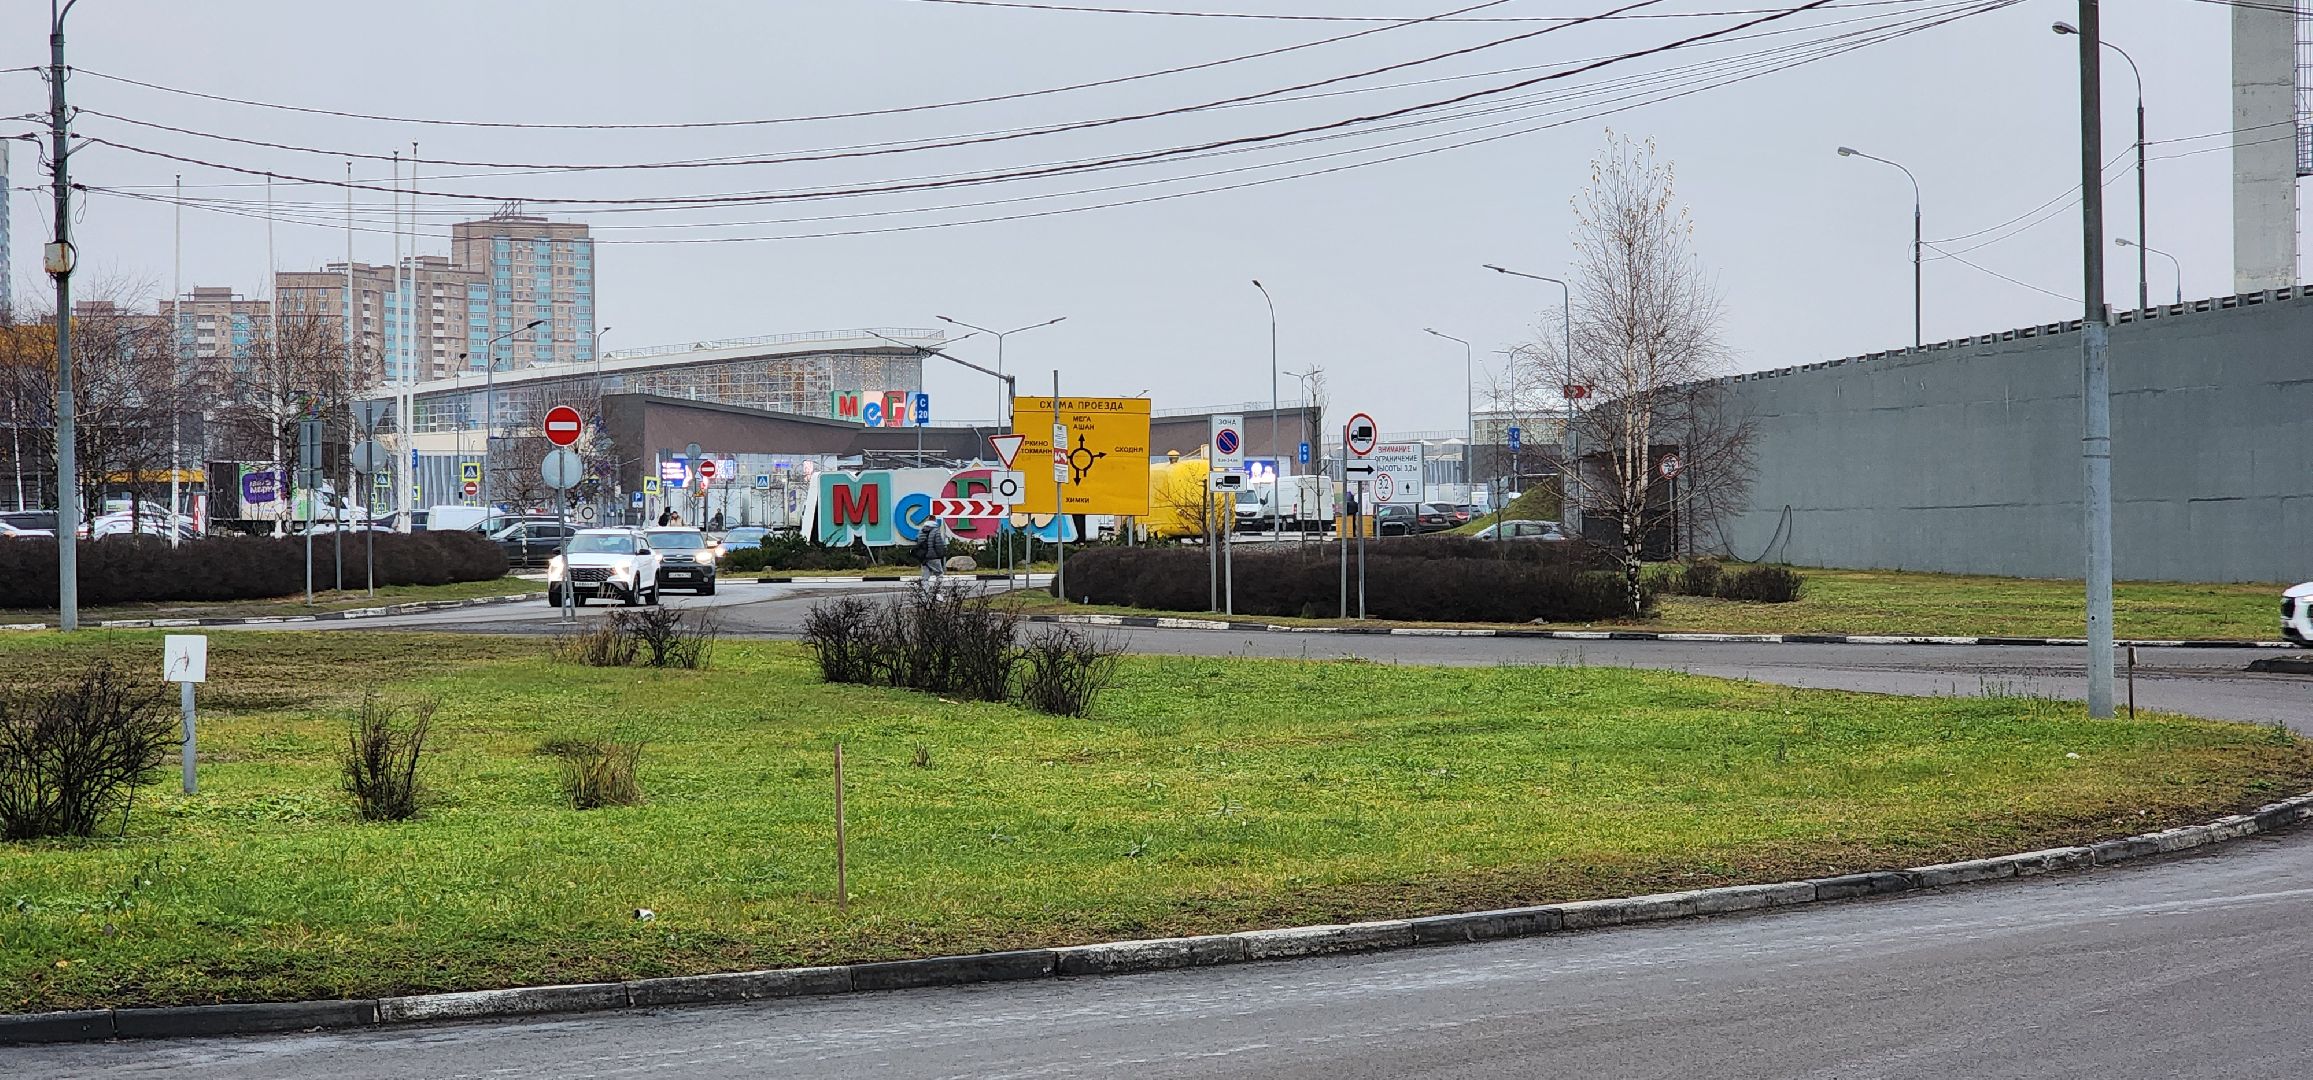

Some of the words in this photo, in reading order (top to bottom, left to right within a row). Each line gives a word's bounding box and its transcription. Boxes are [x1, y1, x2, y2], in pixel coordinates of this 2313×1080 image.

[1039, 400, 1074, 409] СХМА
[1078, 401, 1124, 411] ПРОЕЗДА
[918, 410, 928, 419] 20
[1072, 415, 1092, 423] МЕГА
[1218, 418, 1237, 426] ЗОНА
[1375, 454, 1418, 462] ОГРАНИЧЕНИЕ
